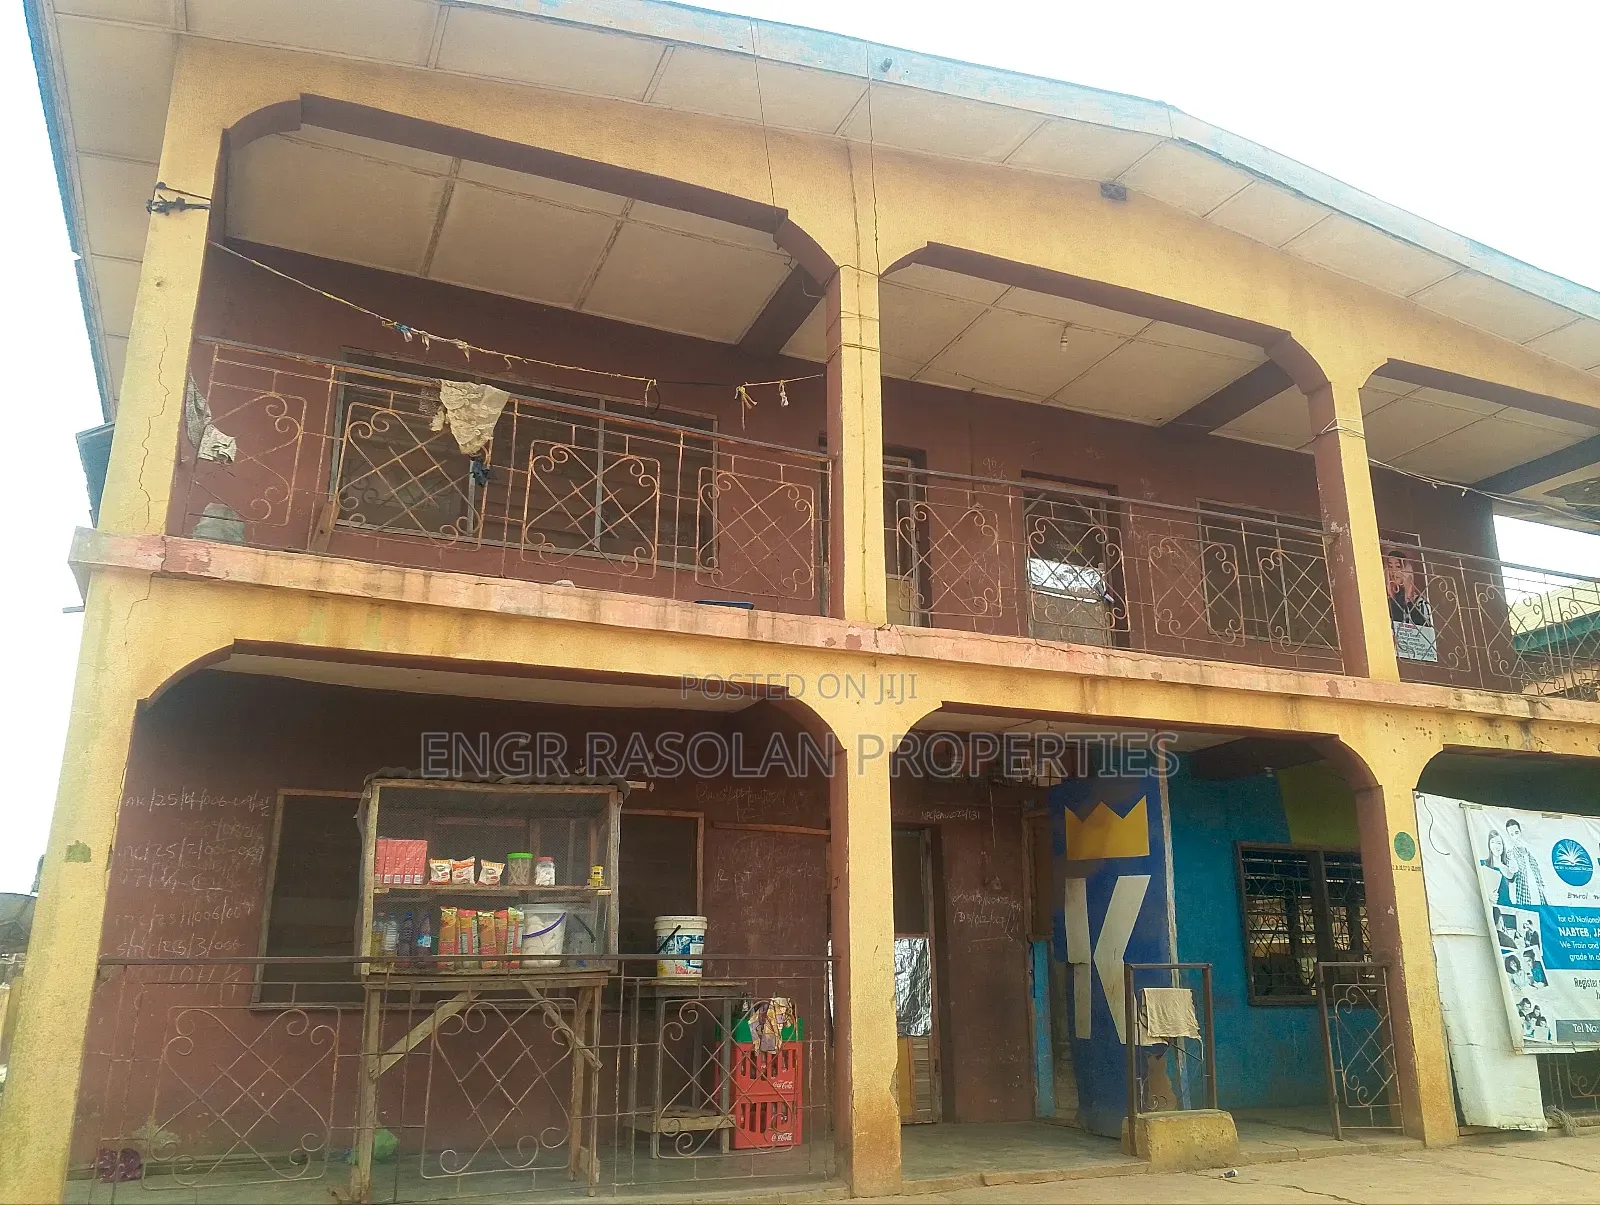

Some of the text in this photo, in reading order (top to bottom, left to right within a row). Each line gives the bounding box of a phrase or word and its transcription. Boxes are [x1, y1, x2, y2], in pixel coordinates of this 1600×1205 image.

[1559, 941, 1571, 949] We
[1065, 875, 1152, 1045] K
[1569, 953, 1588, 962] grade
[1572, 1023, 1584, 1033] Tel
